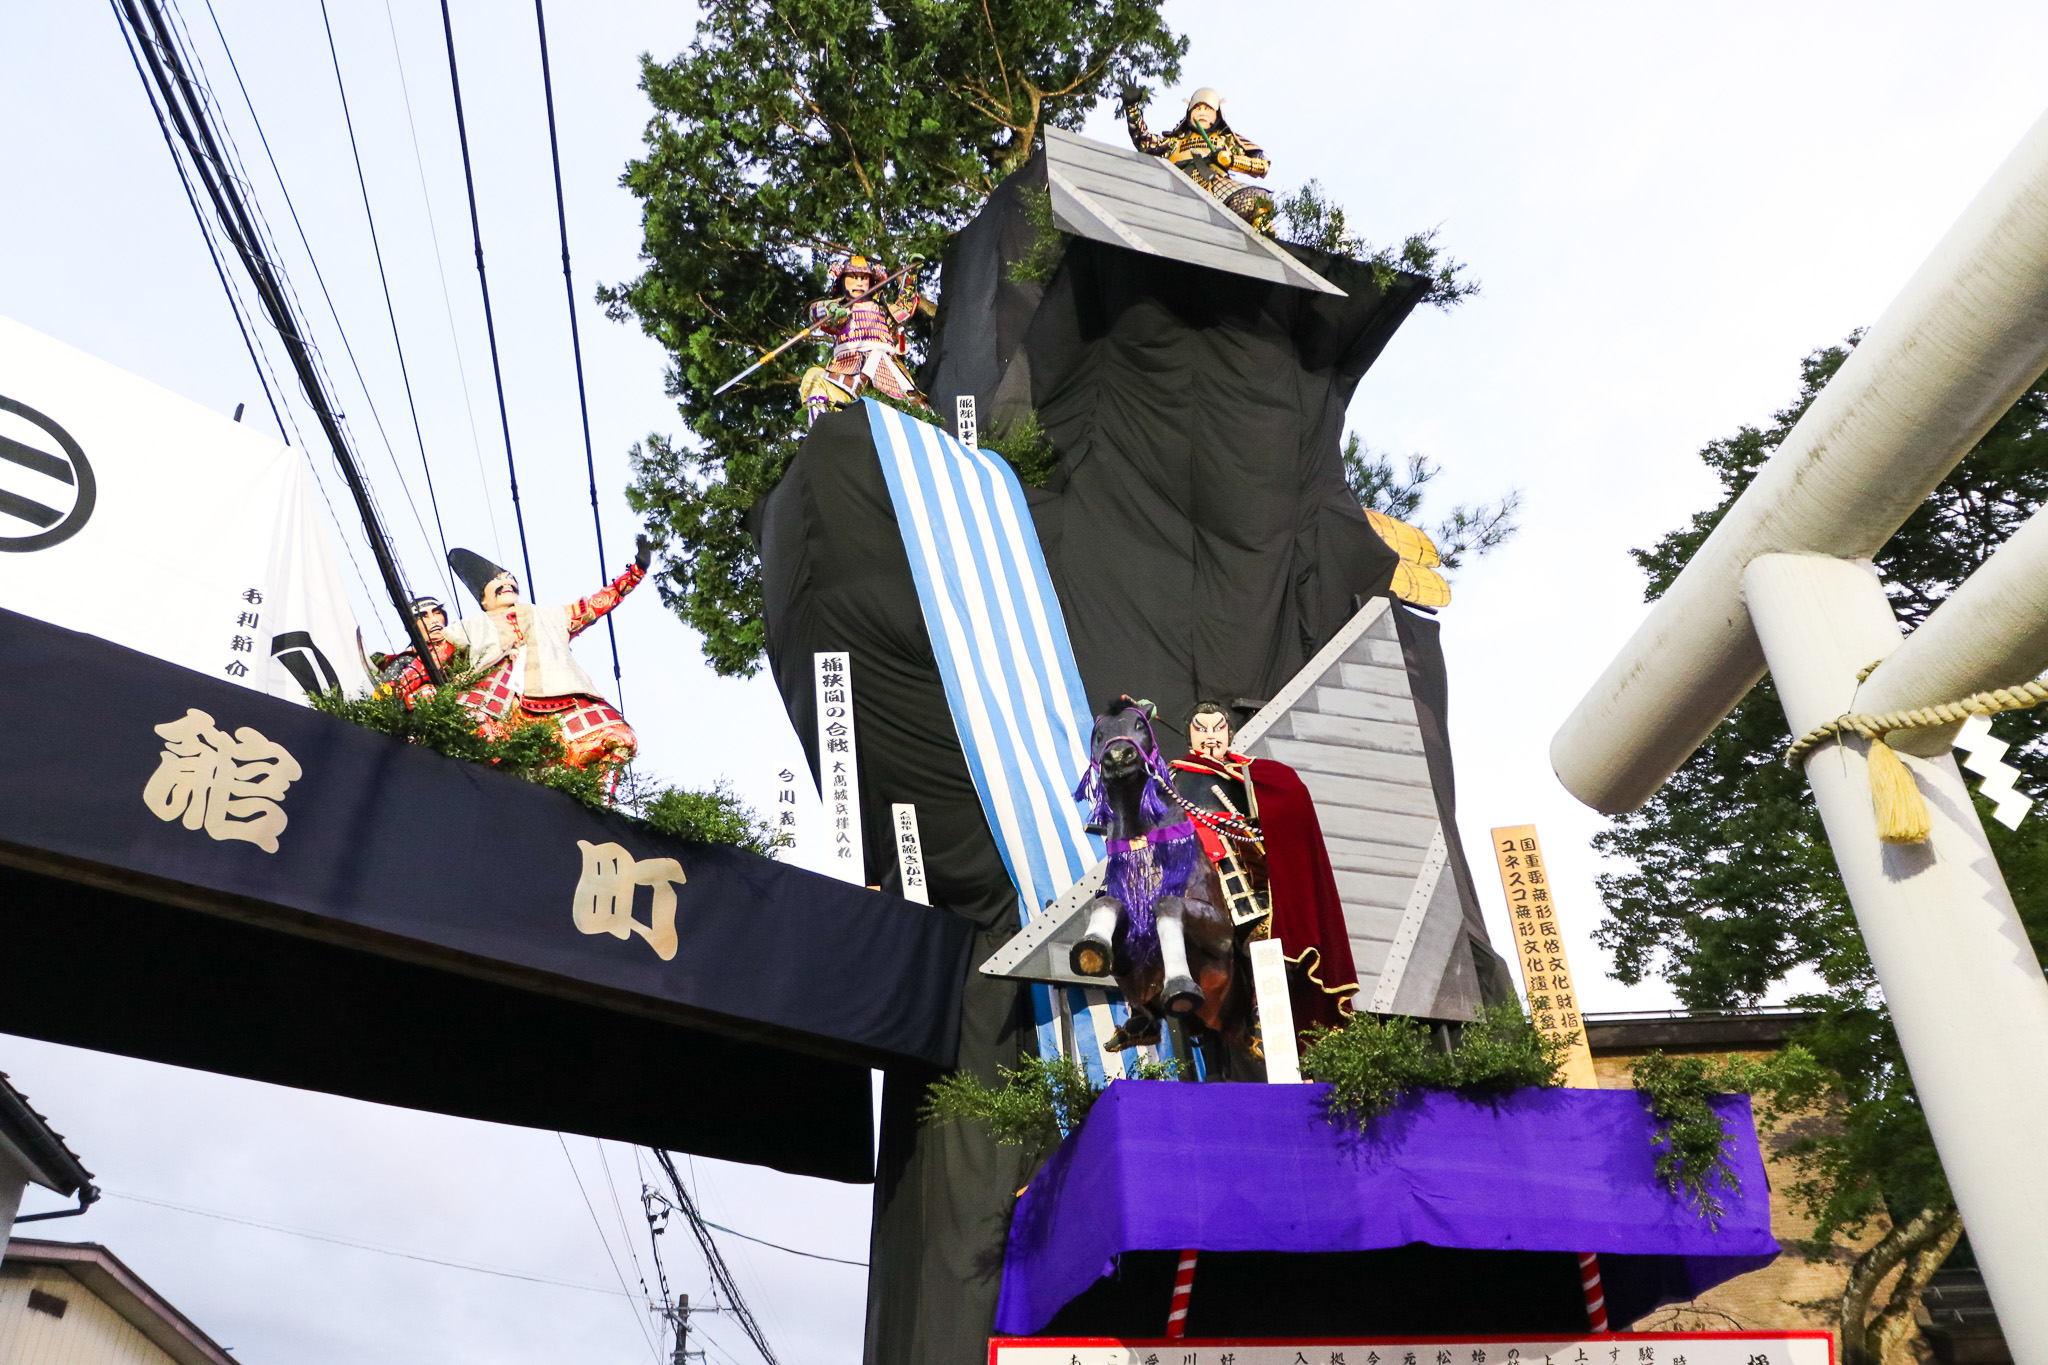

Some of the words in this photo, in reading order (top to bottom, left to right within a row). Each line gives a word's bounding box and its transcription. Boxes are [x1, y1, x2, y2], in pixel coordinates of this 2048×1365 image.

[821, 657, 849, 753] 桶狭間の合戦
[778, 768, 797, 848] 今川義元
